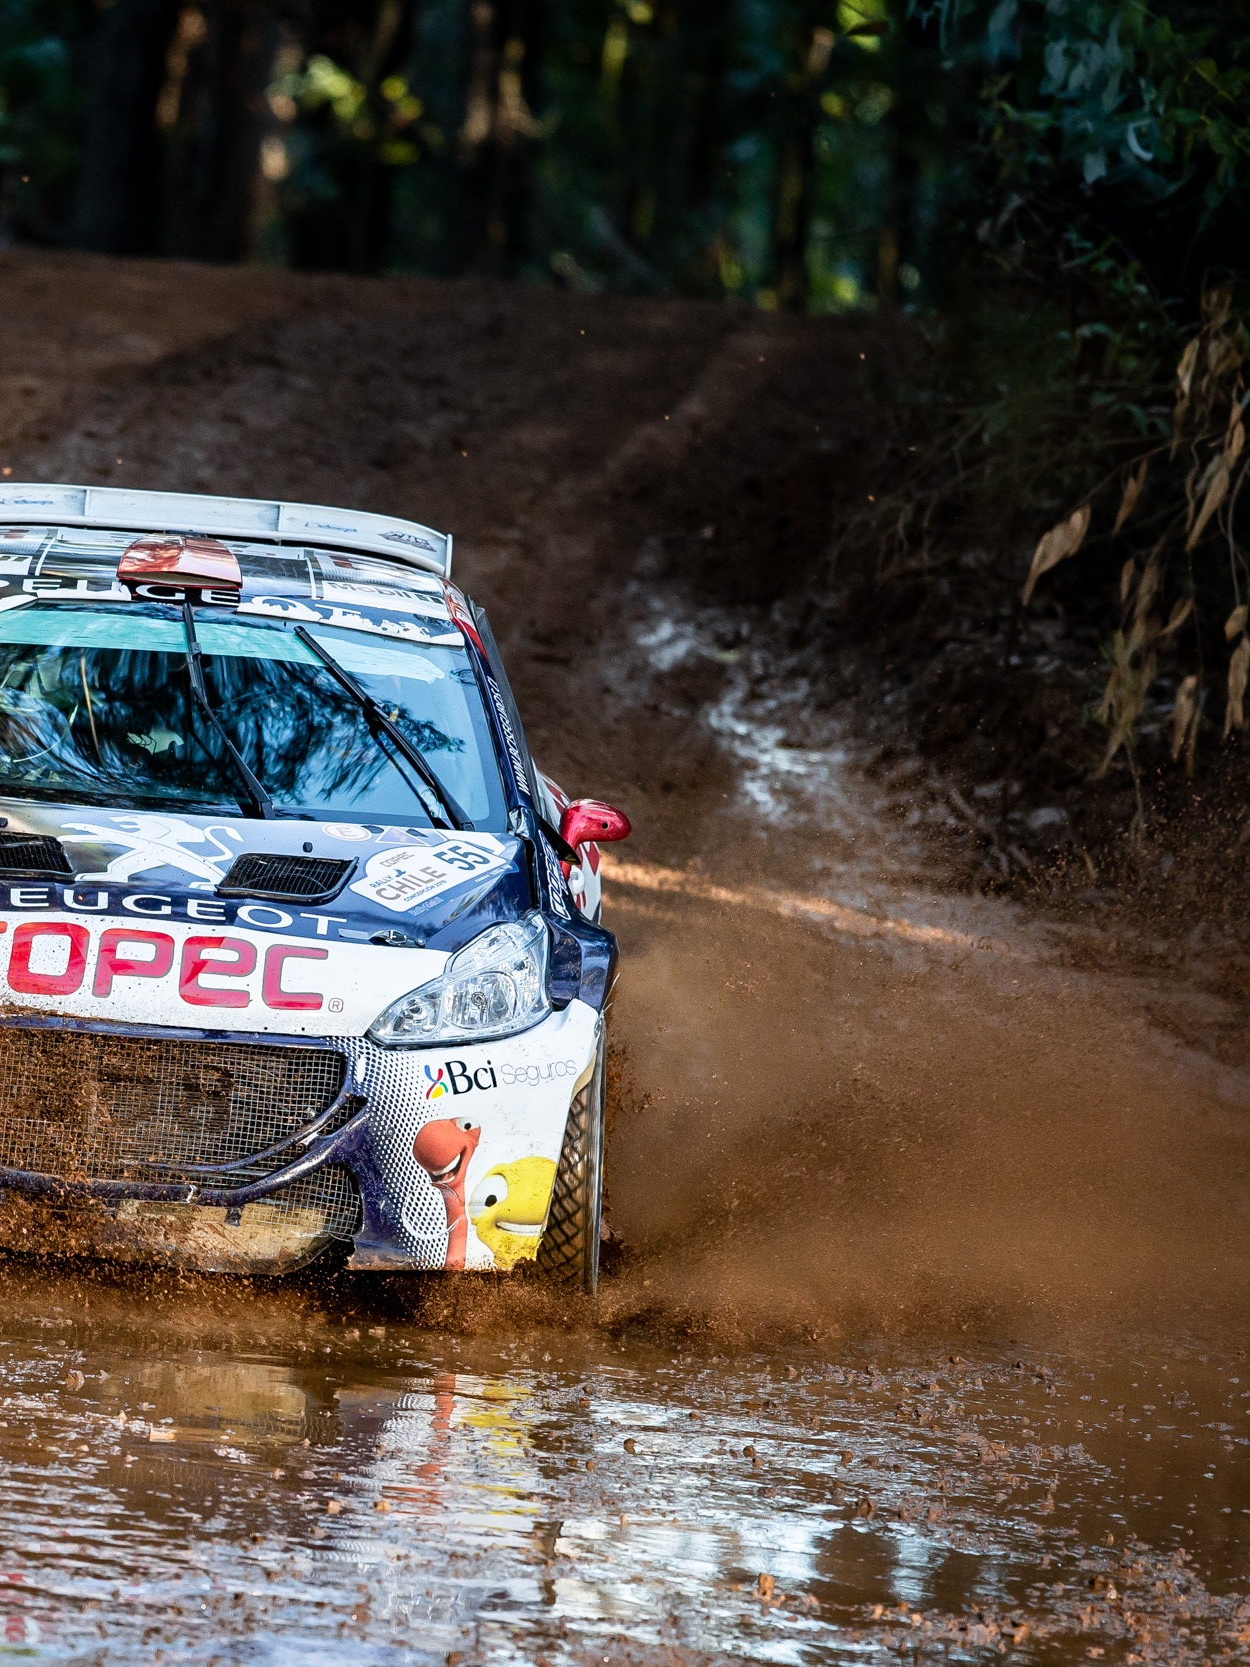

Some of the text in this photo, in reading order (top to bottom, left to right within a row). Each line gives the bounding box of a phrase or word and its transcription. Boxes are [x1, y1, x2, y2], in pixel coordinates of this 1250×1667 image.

[326, 581, 410, 599] Mobil
[433, 845, 491, 871] 55
[369, 874, 394, 889] RALLY
[375, 866, 448, 901] CHILE
[444, 1059, 578, 1096] Bci Seguros
